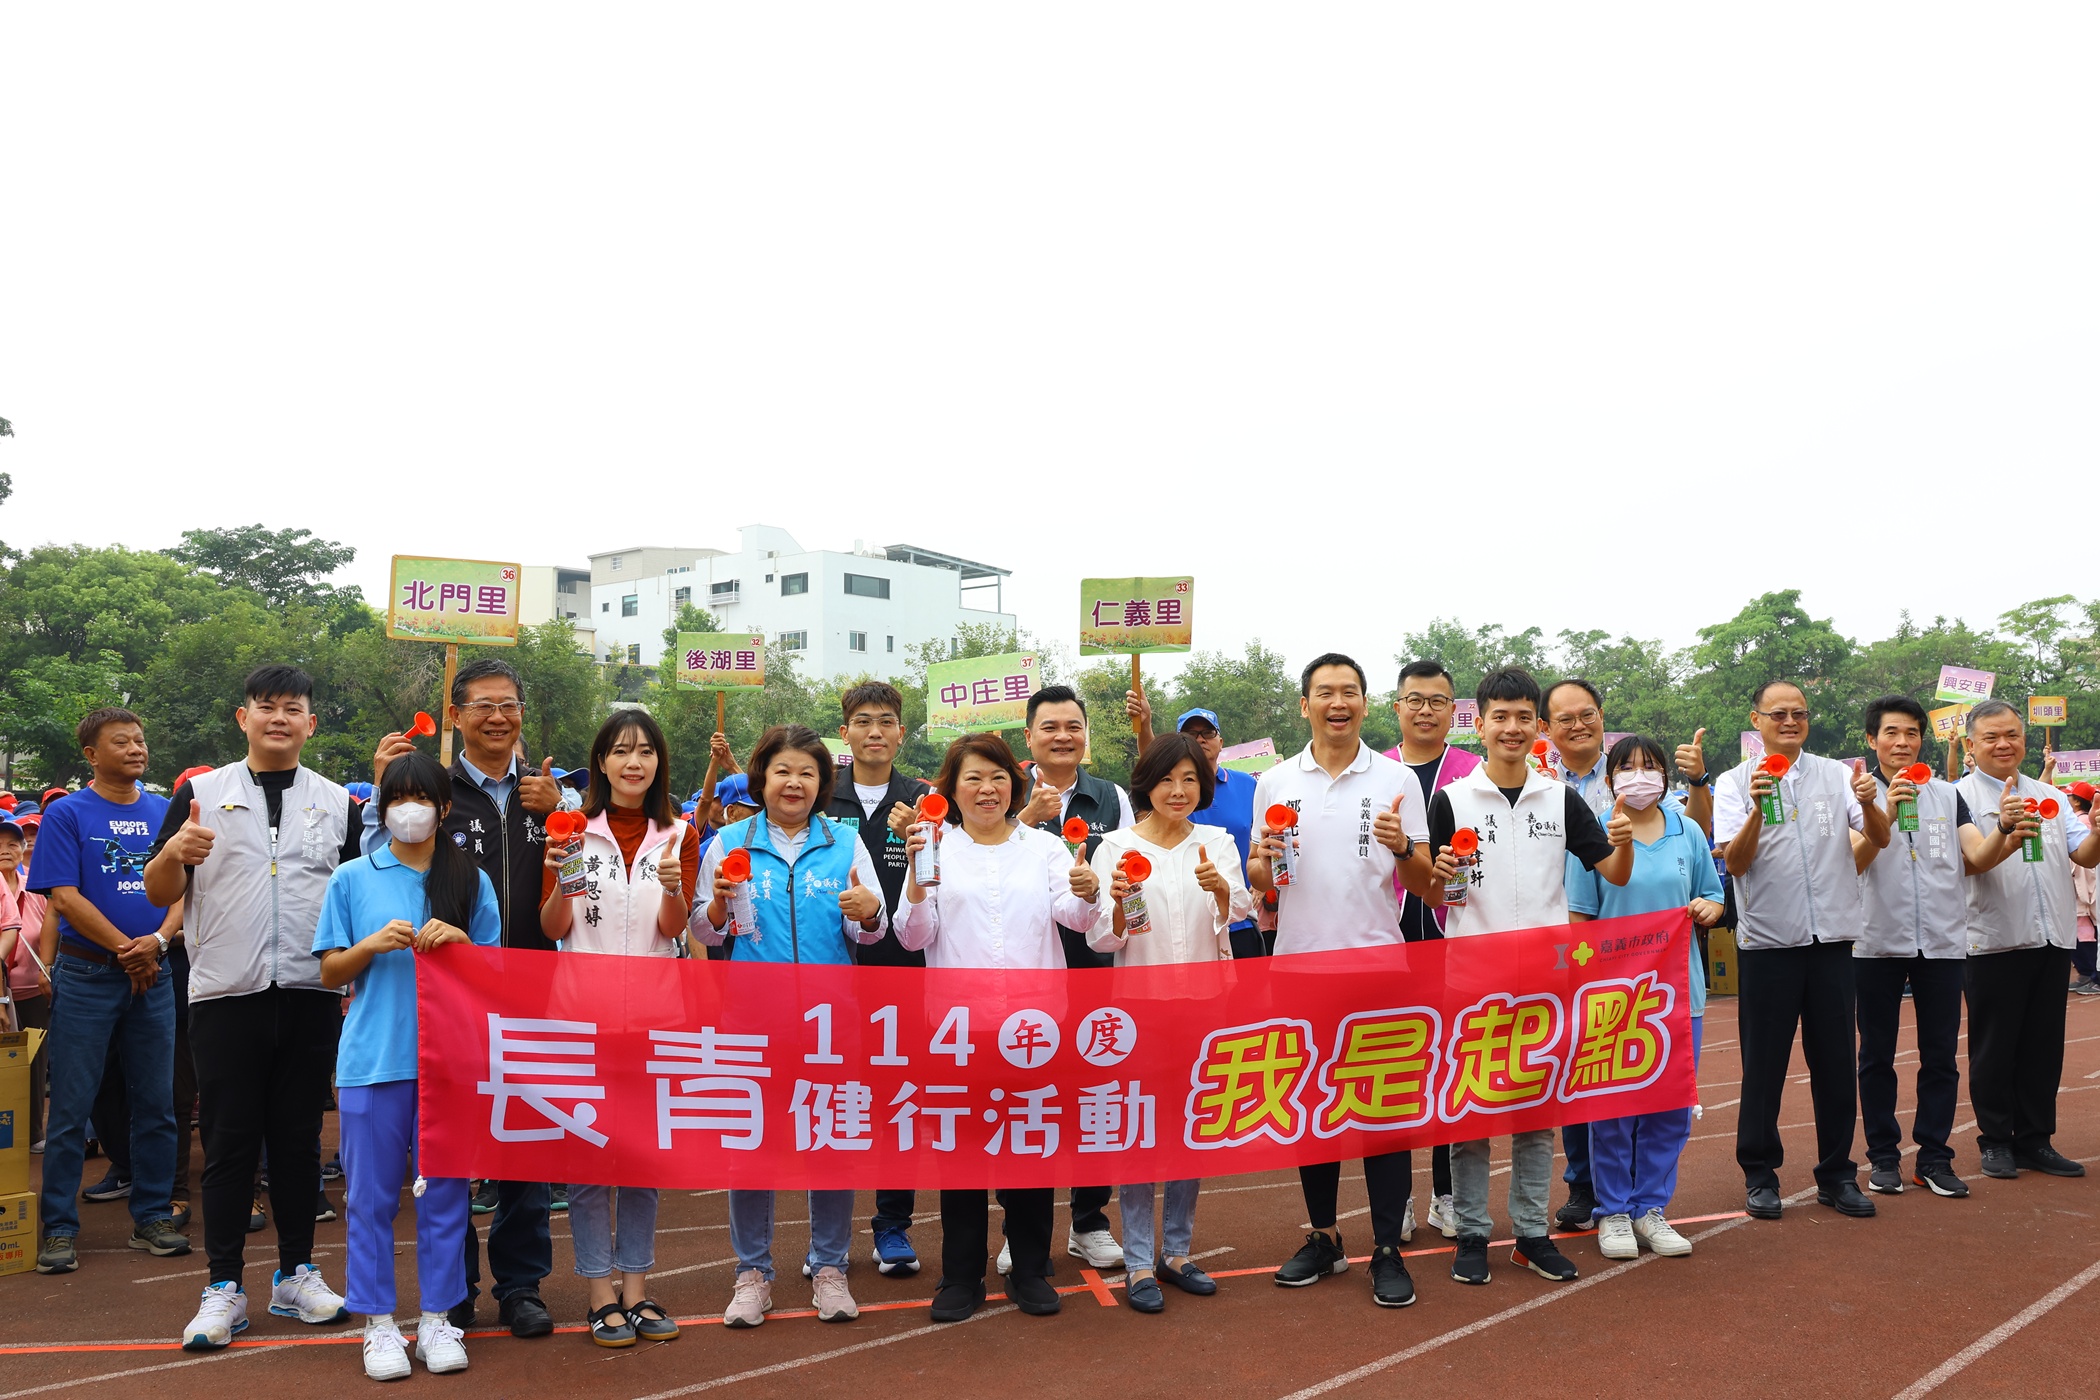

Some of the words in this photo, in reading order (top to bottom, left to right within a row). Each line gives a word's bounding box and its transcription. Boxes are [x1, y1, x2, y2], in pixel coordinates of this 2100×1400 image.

[502, 570, 515, 580] 36
[1177, 583, 1188, 592] 33
[402, 580, 507, 615] 北門里
[1092, 599, 1182, 628] 仁義里
[751, 638, 760, 646] 32
[686, 649, 756, 670] 後湖里
[1022, 658, 1032, 667] 37
[941, 674, 1032, 709] 中庄里
[1943, 676, 1987, 694] 興安里
[1937, 712, 1970, 731] 王田
[2033, 706, 2063, 716] 圳頭里
[2057, 759, 2100, 774] 豐年里
[109, 820, 148, 828] EUROPE
[110, 826, 135, 836] TOP
[136, 827, 150, 836] 12
[469, 818, 485, 855] 議員
[1358, 797, 1372, 858] 嘉義市議員
[1484, 814, 1498, 844] 議員
[1929, 823, 1941, 858] 柯國振
[608, 855, 620, 880] 議員
[584, 854, 603, 928] 黃思婷
[762, 869, 773, 901] 市議員
[1600, 930, 1669, 954] 嘉義市政府
[1192, 976, 1668, 1144] 我是起點
[476, 1012, 772, 1150] 長青
[788, 1079, 1157, 1159] 健行活動
